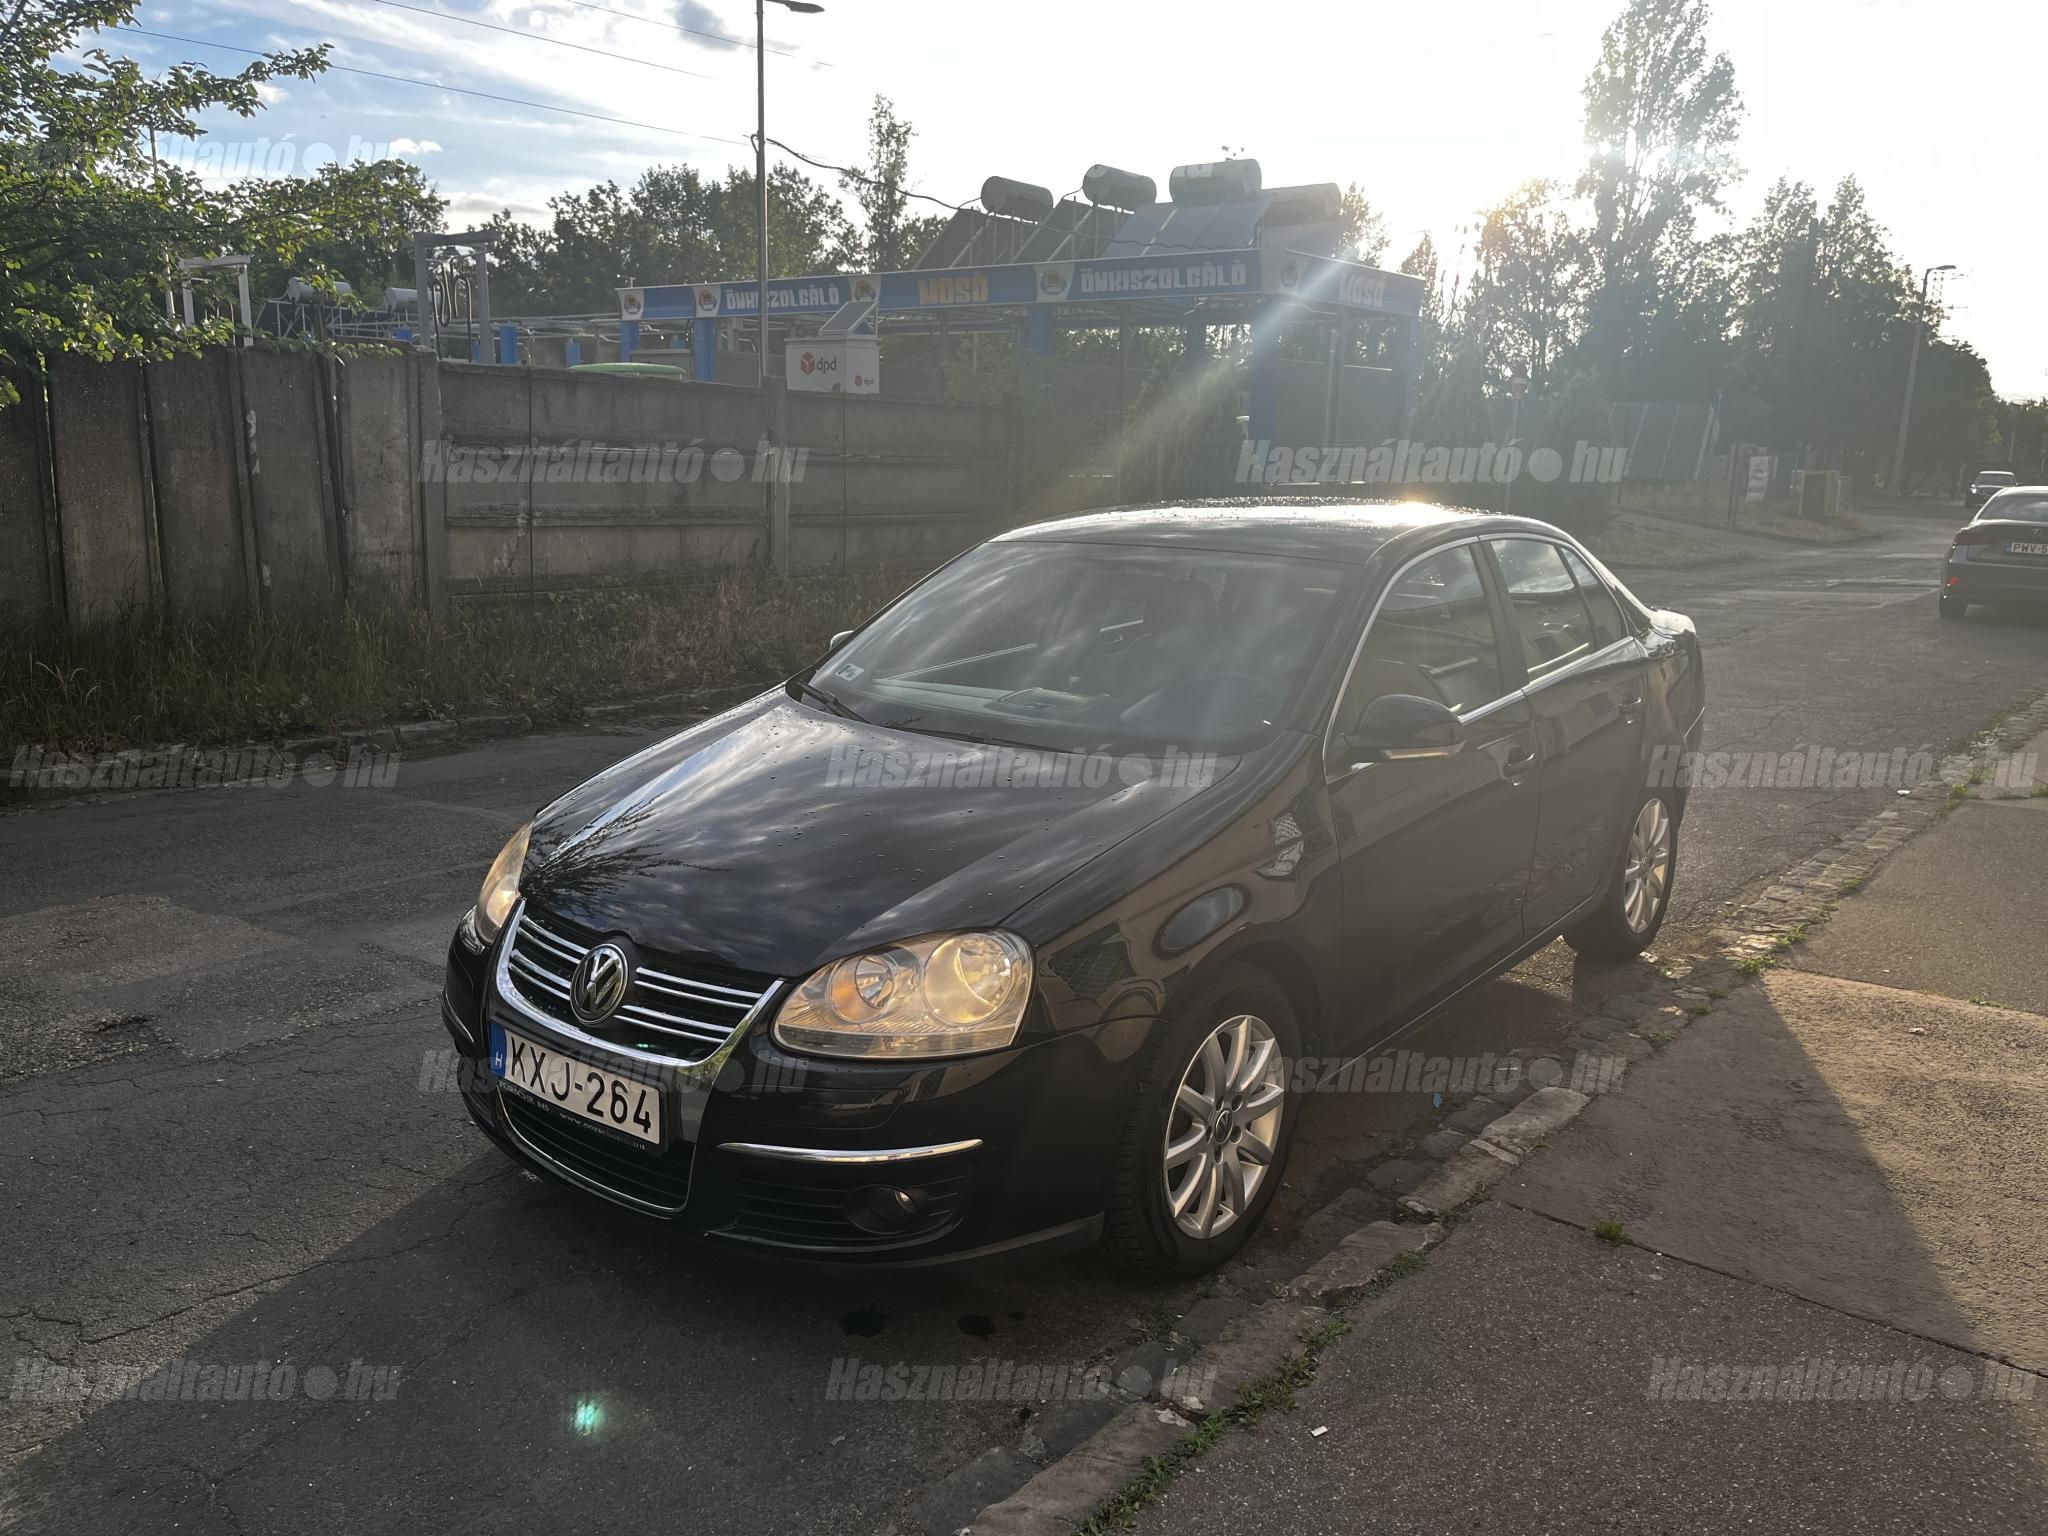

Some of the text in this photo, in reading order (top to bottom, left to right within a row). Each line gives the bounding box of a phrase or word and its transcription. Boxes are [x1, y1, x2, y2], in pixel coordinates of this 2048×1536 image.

[1080, 260, 1247, 293] ÖNKISZOLGÁLÓ
[725, 283, 840, 310] ÖNKIZOLGÁLÓ
[816, 356, 837, 375] dpd
[511, 1037, 652, 1134] KXJ-264
